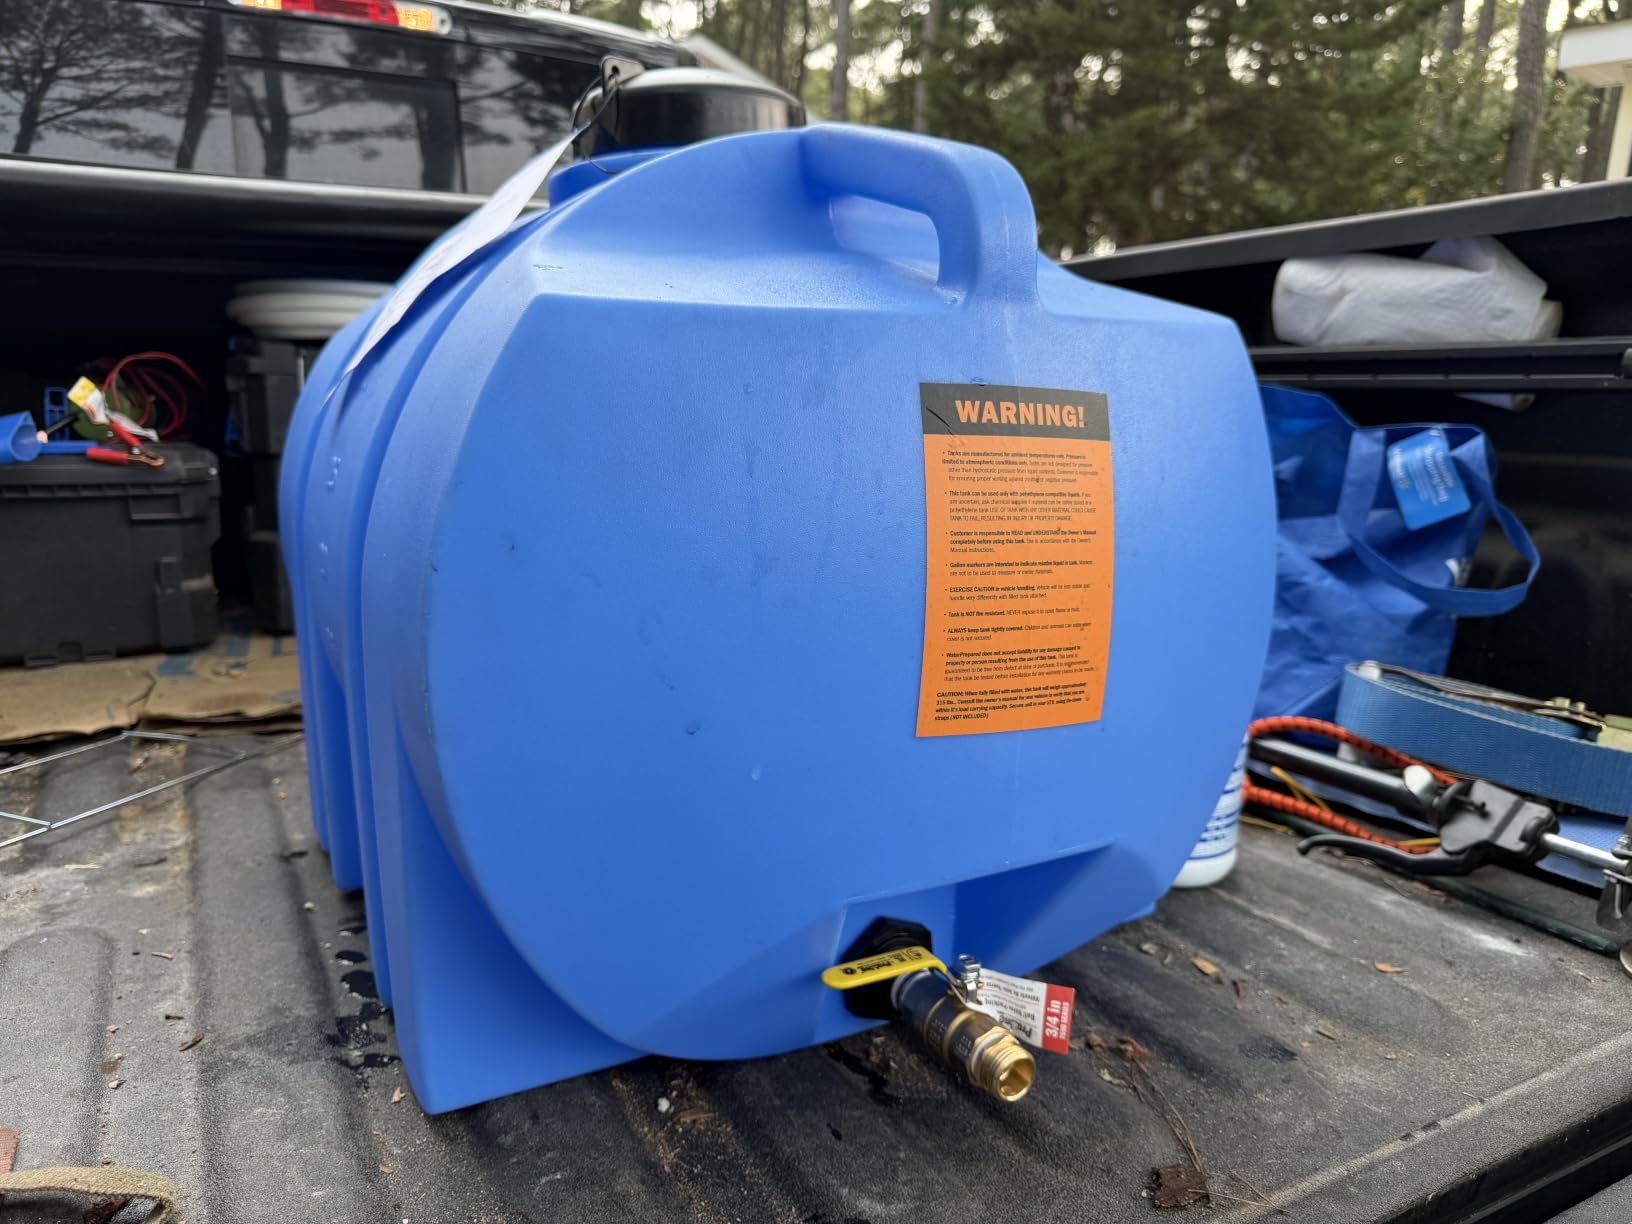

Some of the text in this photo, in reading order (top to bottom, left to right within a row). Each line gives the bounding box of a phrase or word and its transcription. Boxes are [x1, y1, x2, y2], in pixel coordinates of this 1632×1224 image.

[955, 400, 1085, 428] WARNING!
[963, 712, 989, 720] INCLUDED)
[1044, 999, 1062, 1039] 3/4 in
